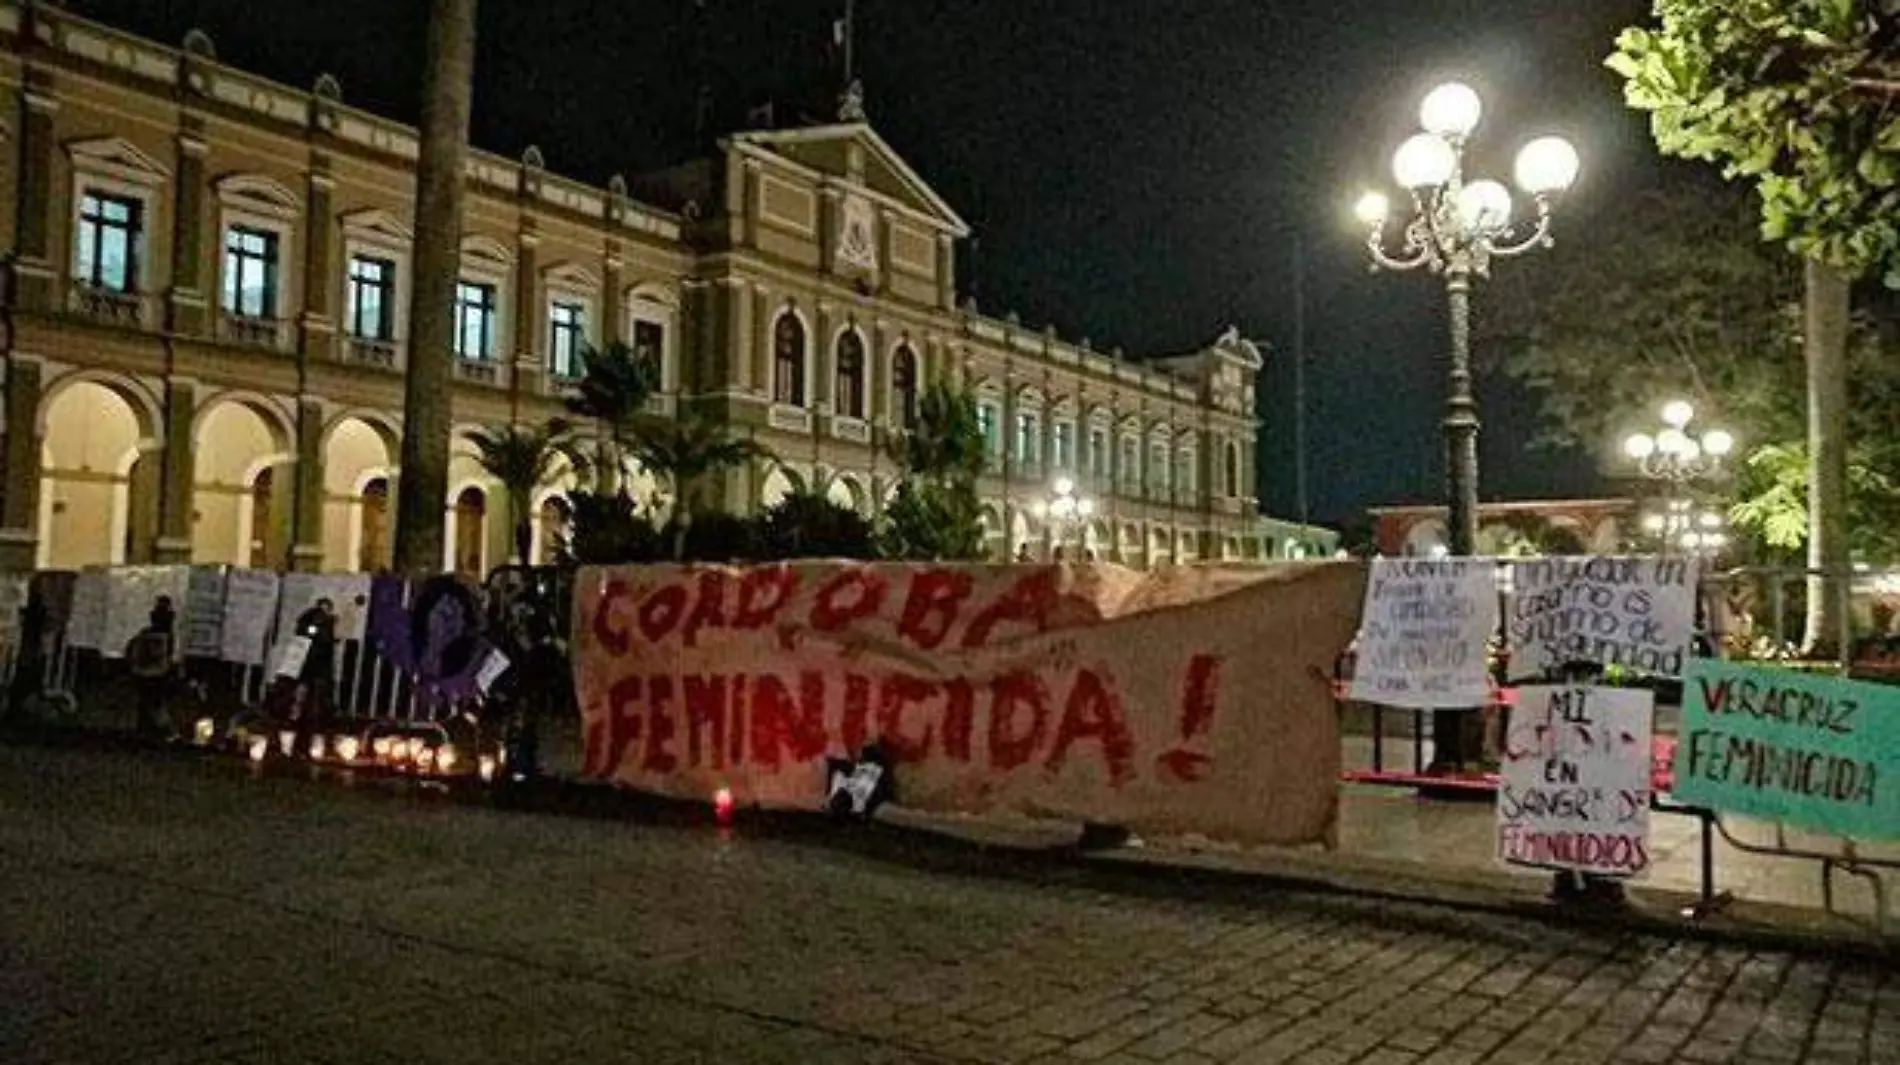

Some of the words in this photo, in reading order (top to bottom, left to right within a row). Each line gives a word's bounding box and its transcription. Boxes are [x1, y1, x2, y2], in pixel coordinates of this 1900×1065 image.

[1548, 688, 1592, 725] MI
[1698, 675, 1858, 734] VERACRUZ
[1543, 758, 1578, 785] EN
[1689, 728, 1877, 807] FEMINICIDA
